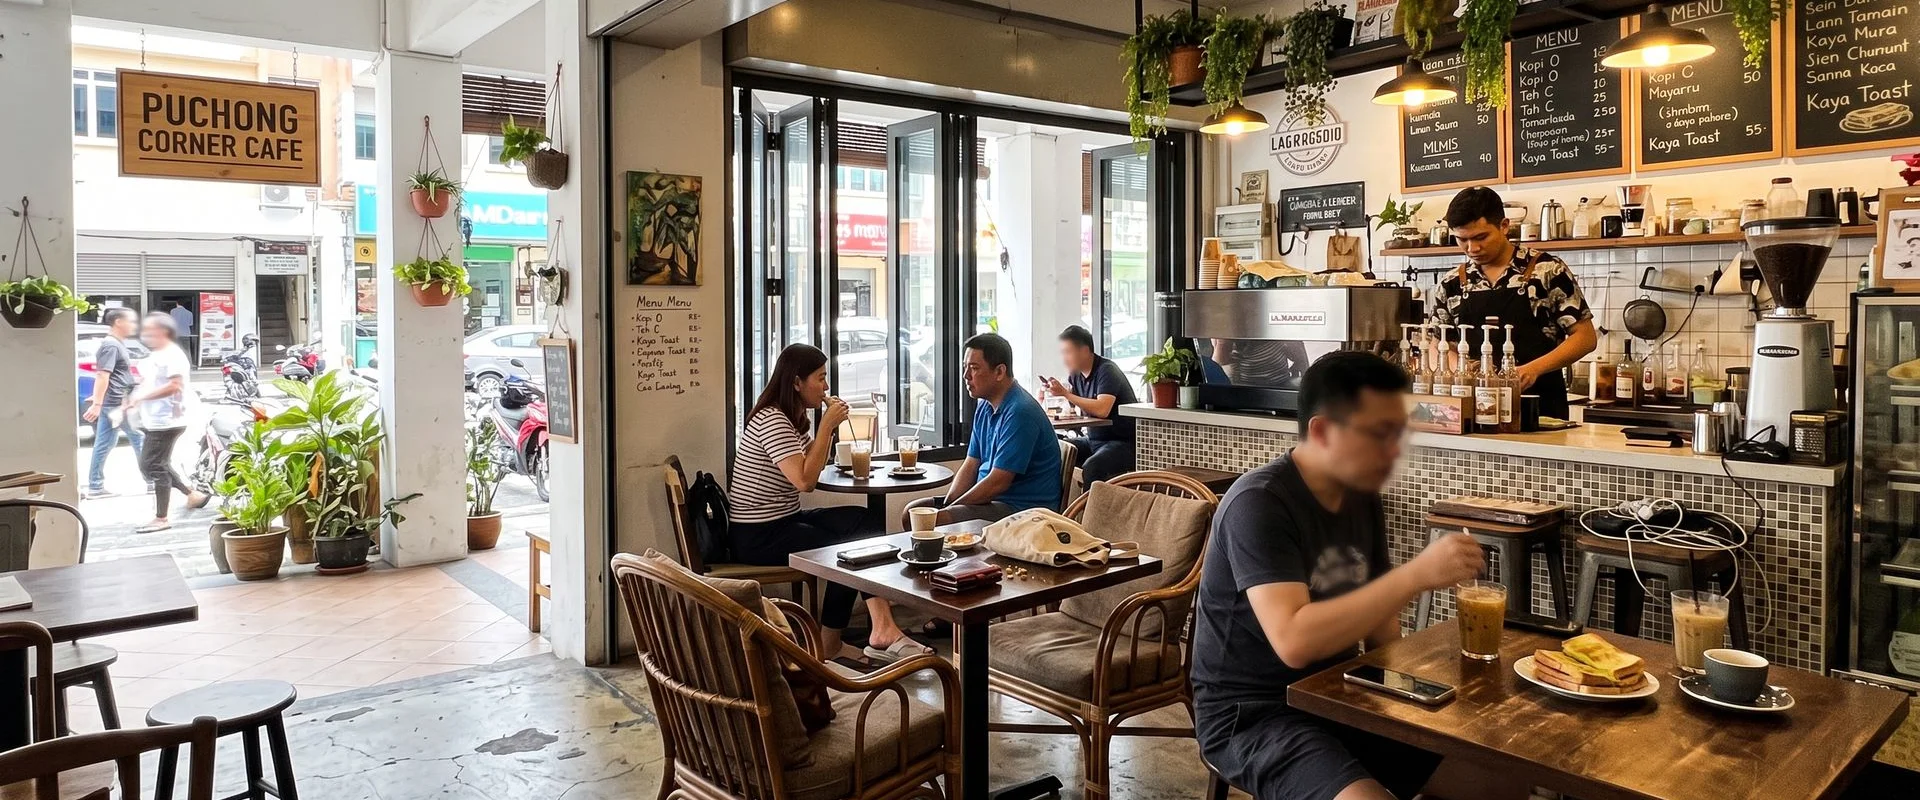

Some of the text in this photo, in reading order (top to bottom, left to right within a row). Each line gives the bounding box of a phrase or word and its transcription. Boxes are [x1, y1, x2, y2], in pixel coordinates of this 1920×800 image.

[1671, 0, 1723, 21] MENU
[1806, 1, 1836, 15] Sein
[1806, 5, 1908, 31] Lann Tamain
[1536, 28, 1579, 49] MENU
[1806, 26, 1897, 50] Kaya Mura
[1520, 58, 1544, 73] Kopi
[1550, 54, 1560, 67] O
[1806, 52, 1839, 67] Sien
[1520, 75, 1543, 88] Kopi
[1548, 70, 1558, 82] O
[1649, 65, 1761, 85] Kopi C 50
[1806, 69, 1852, 84] Sanna
[1520, 78, 1606, 101] Teh C 10
[1807, 79, 1913, 114] Kaya Toast
[1545, 100, 1554, 112] C
[1593, 92, 1607, 103] 25
[142, 92, 298, 134] PUCHONG
[1477, 114, 1489, 125] 50
[1593, 106, 1616, 118] 250
[138, 128, 303, 162] CORNER CAFE
[1649, 137, 1680, 153] Kaya
[1684, 129, 1720, 146] Toast
[1480, 153, 1492, 163] 40
[1521, 152, 1546, 166] Kaya
[1550, 145, 1580, 160] Toast
[637, 296, 692, 308] Menu Menu
[655, 313, 663, 323] O
[654, 325, 660, 334] C
[660, 336, 680, 344] Toast
[658, 369, 677, 377] Toast
